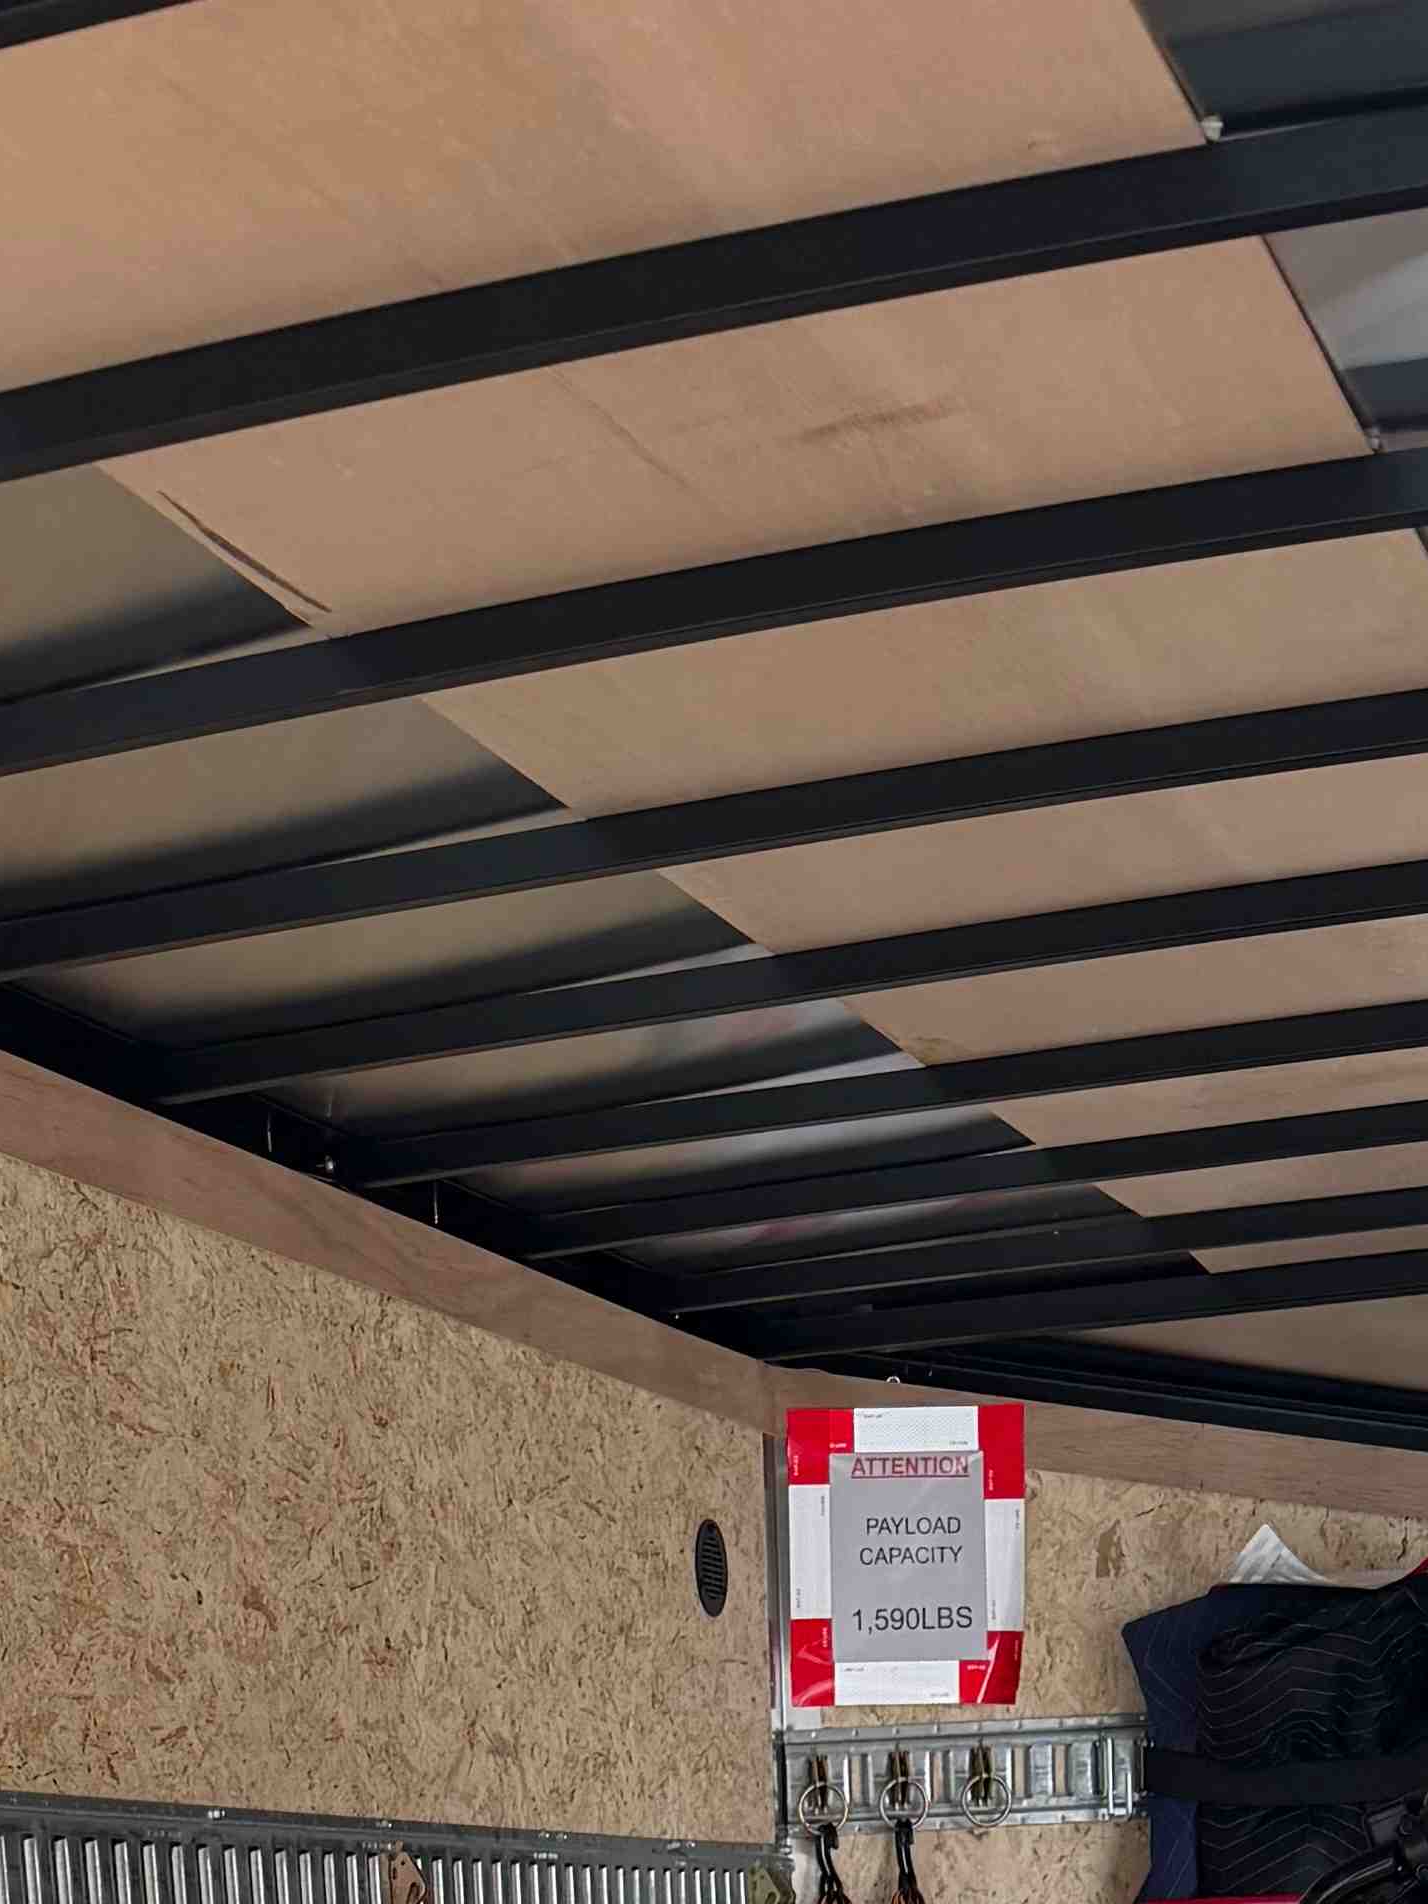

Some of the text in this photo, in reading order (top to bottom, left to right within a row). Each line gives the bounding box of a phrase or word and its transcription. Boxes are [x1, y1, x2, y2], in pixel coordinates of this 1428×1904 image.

[851, 1456, 969, 1477] ATTENTION
[866, 1516, 961, 1535] PAYLOAD
[859, 1546, 963, 1565] CAPACITY
[852, 1606, 973, 1635] 1,590LBS
